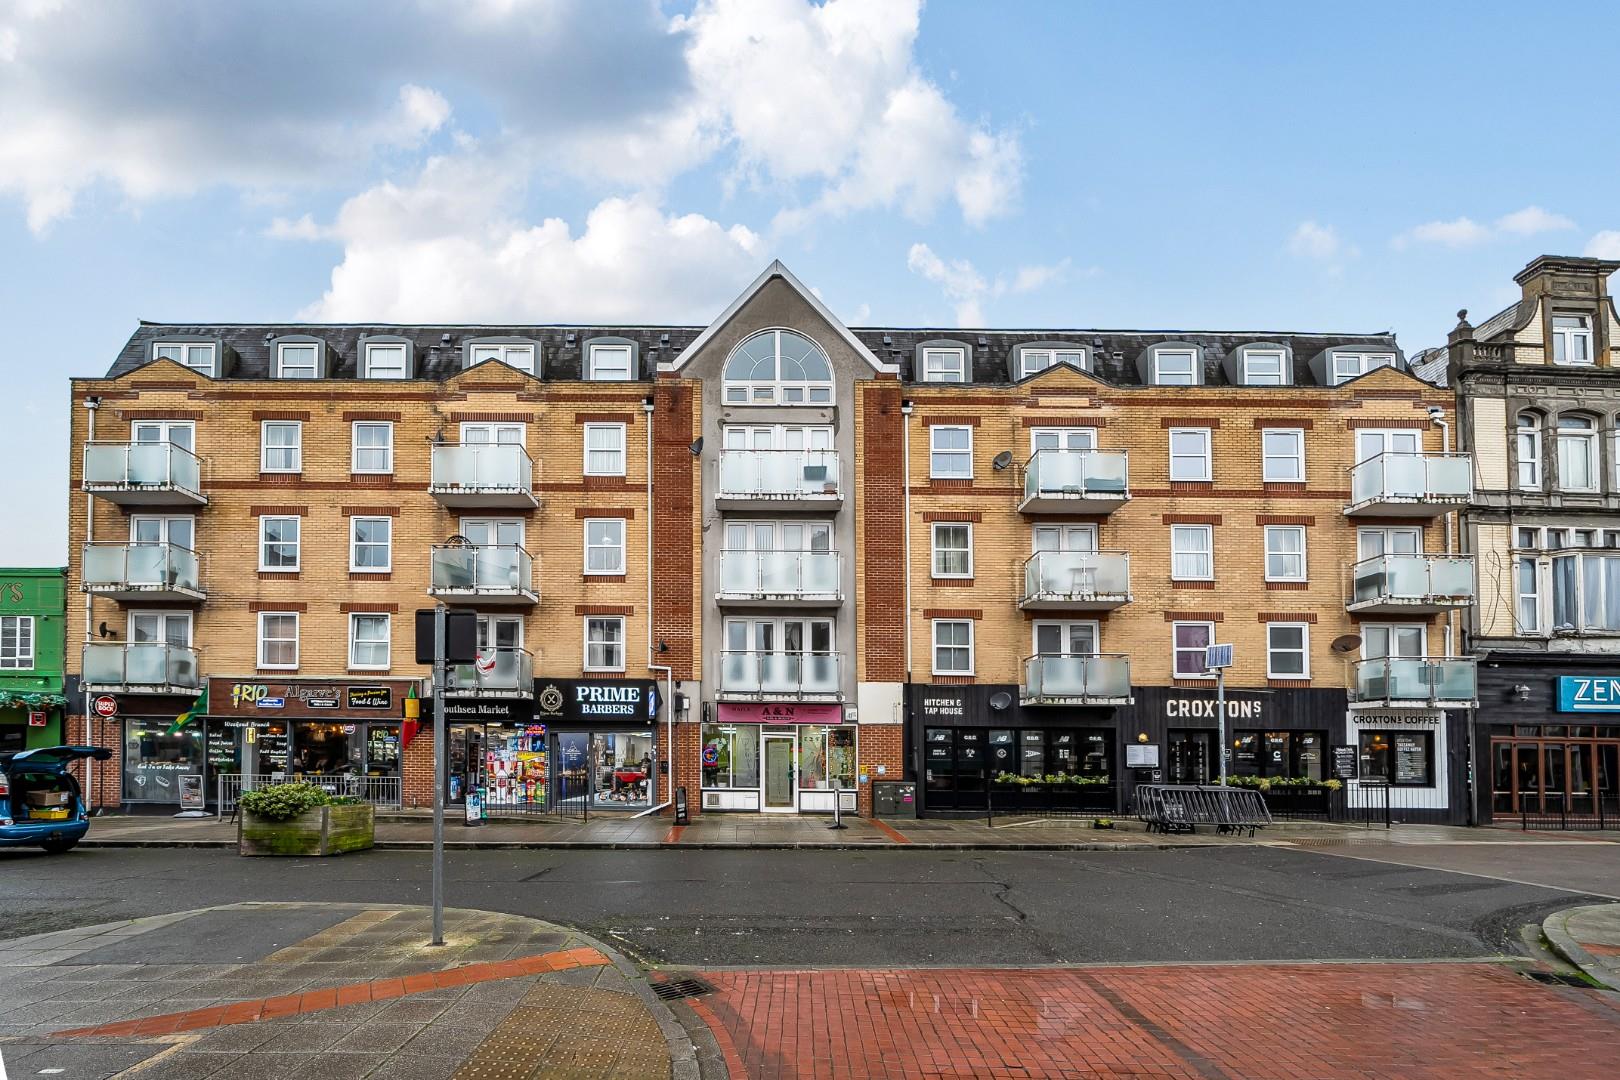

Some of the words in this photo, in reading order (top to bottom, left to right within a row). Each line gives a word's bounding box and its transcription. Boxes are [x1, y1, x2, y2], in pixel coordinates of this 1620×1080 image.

[242, 685, 268, 701] RIO
[576, 686, 640, 702] PRIME
[351, 697, 366, 705] Food
[372, 697, 388, 705] Wine
[443, 705, 476, 714] outhsea
[478, 705, 509, 714] Market
[582, 704, 634, 715] BARBERS
[762, 707, 771, 716] A
[773, 707, 782, 716] &
[785, 707, 795, 716] N
[924, 707, 938, 715] TAP
[940, 707, 963, 715] HOUSE
[1166, 699, 1261, 718] CROXONS
[1404, 716, 1440, 724] COFFEE
